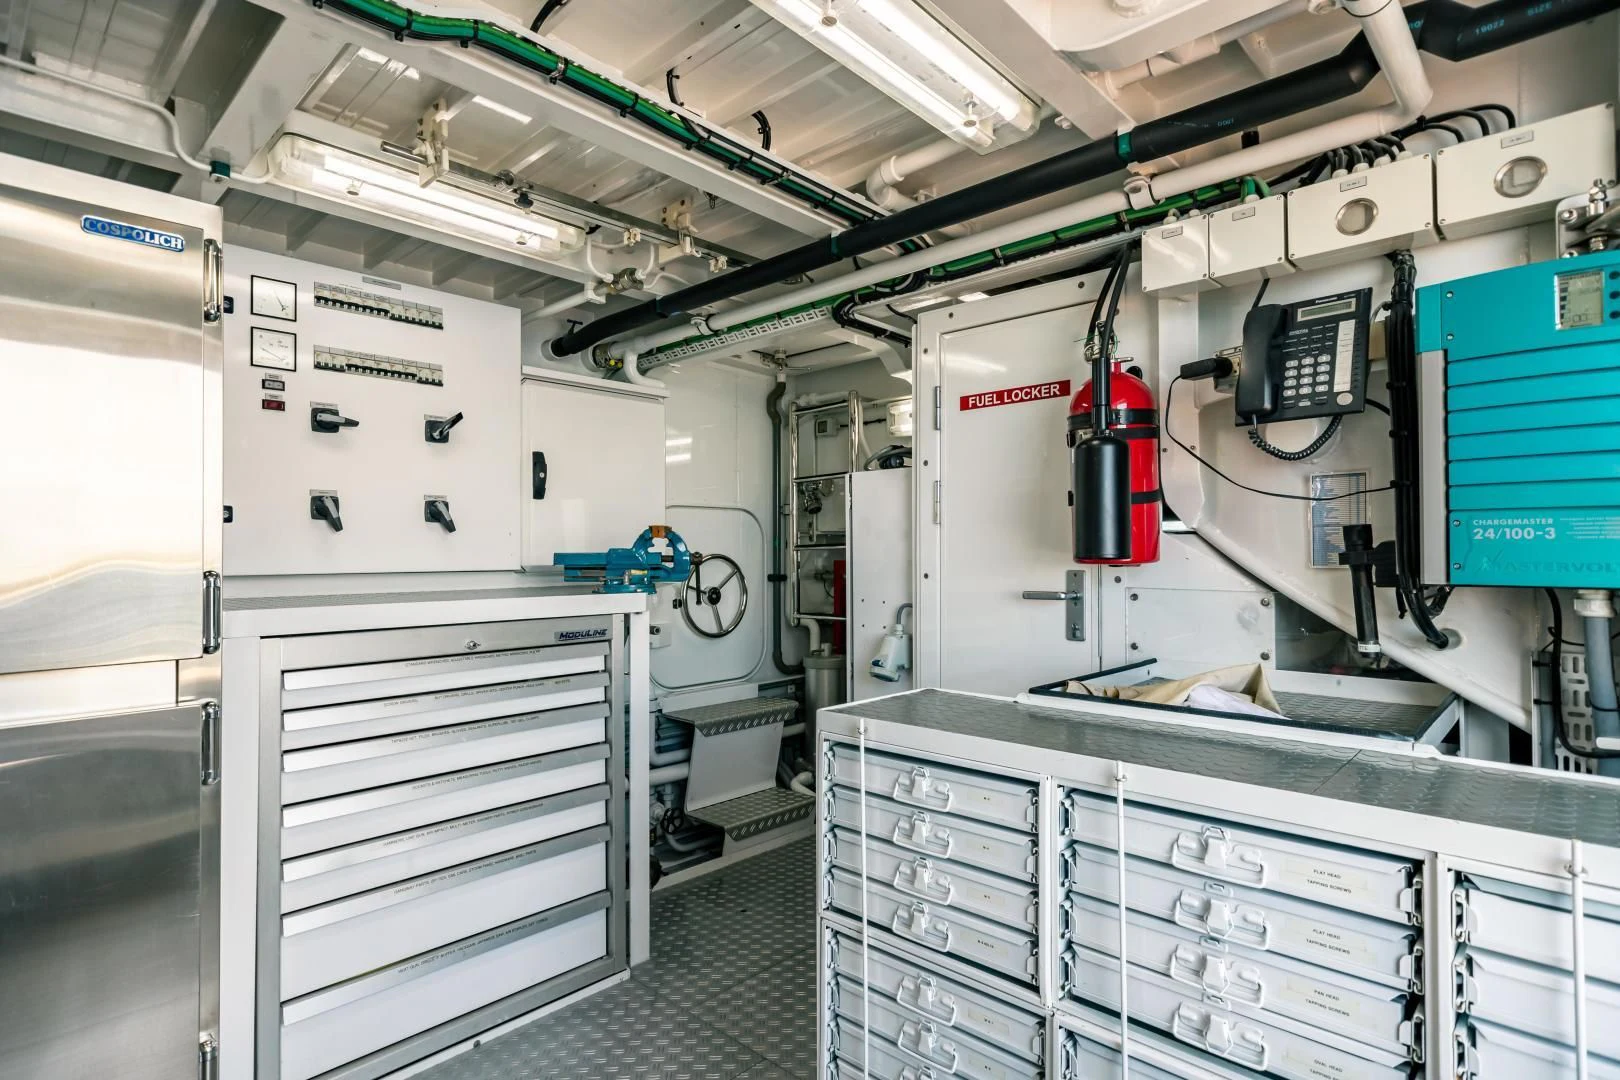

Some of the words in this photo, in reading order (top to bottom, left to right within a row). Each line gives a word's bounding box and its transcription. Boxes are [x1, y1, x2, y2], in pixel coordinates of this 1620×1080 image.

[84, 219, 184, 249] COSPOLICH
[968, 393, 1001, 408] FUEL
[1003, 383, 1060, 403] LOCKER
[1473, 518, 1553, 526] CHARGEMASTER
[1473, 527, 1556, 540] 24/100-3
